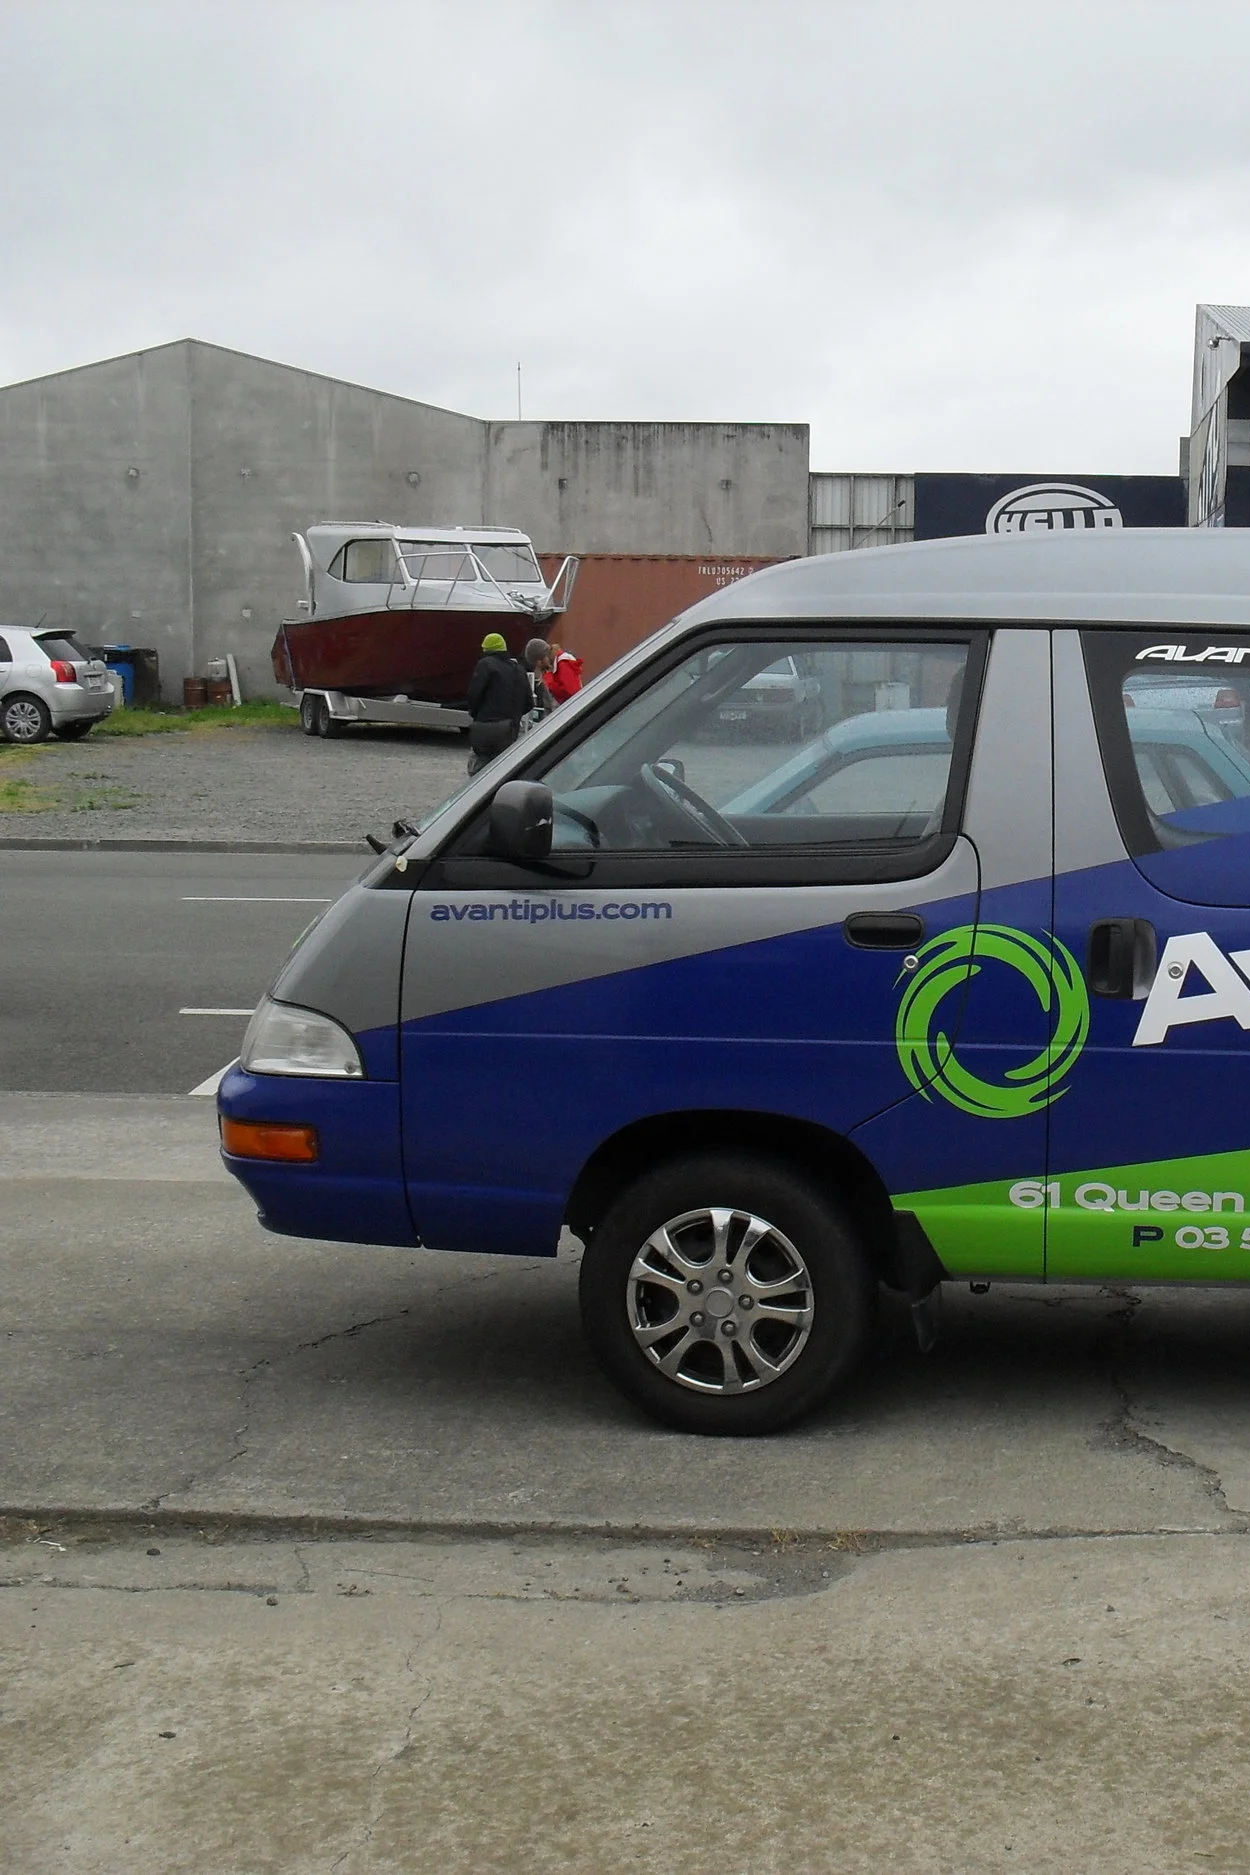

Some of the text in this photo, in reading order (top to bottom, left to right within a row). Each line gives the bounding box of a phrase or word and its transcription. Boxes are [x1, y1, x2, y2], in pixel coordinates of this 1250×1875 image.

[430, 899, 672, 924] avantiplus.com
[1008, 1181, 1060, 1209] 61
[1074, 1183, 1245, 1212] Queen
[1132, 1225, 1164, 1247] P
[1174, 1226, 1230, 1249] 03
